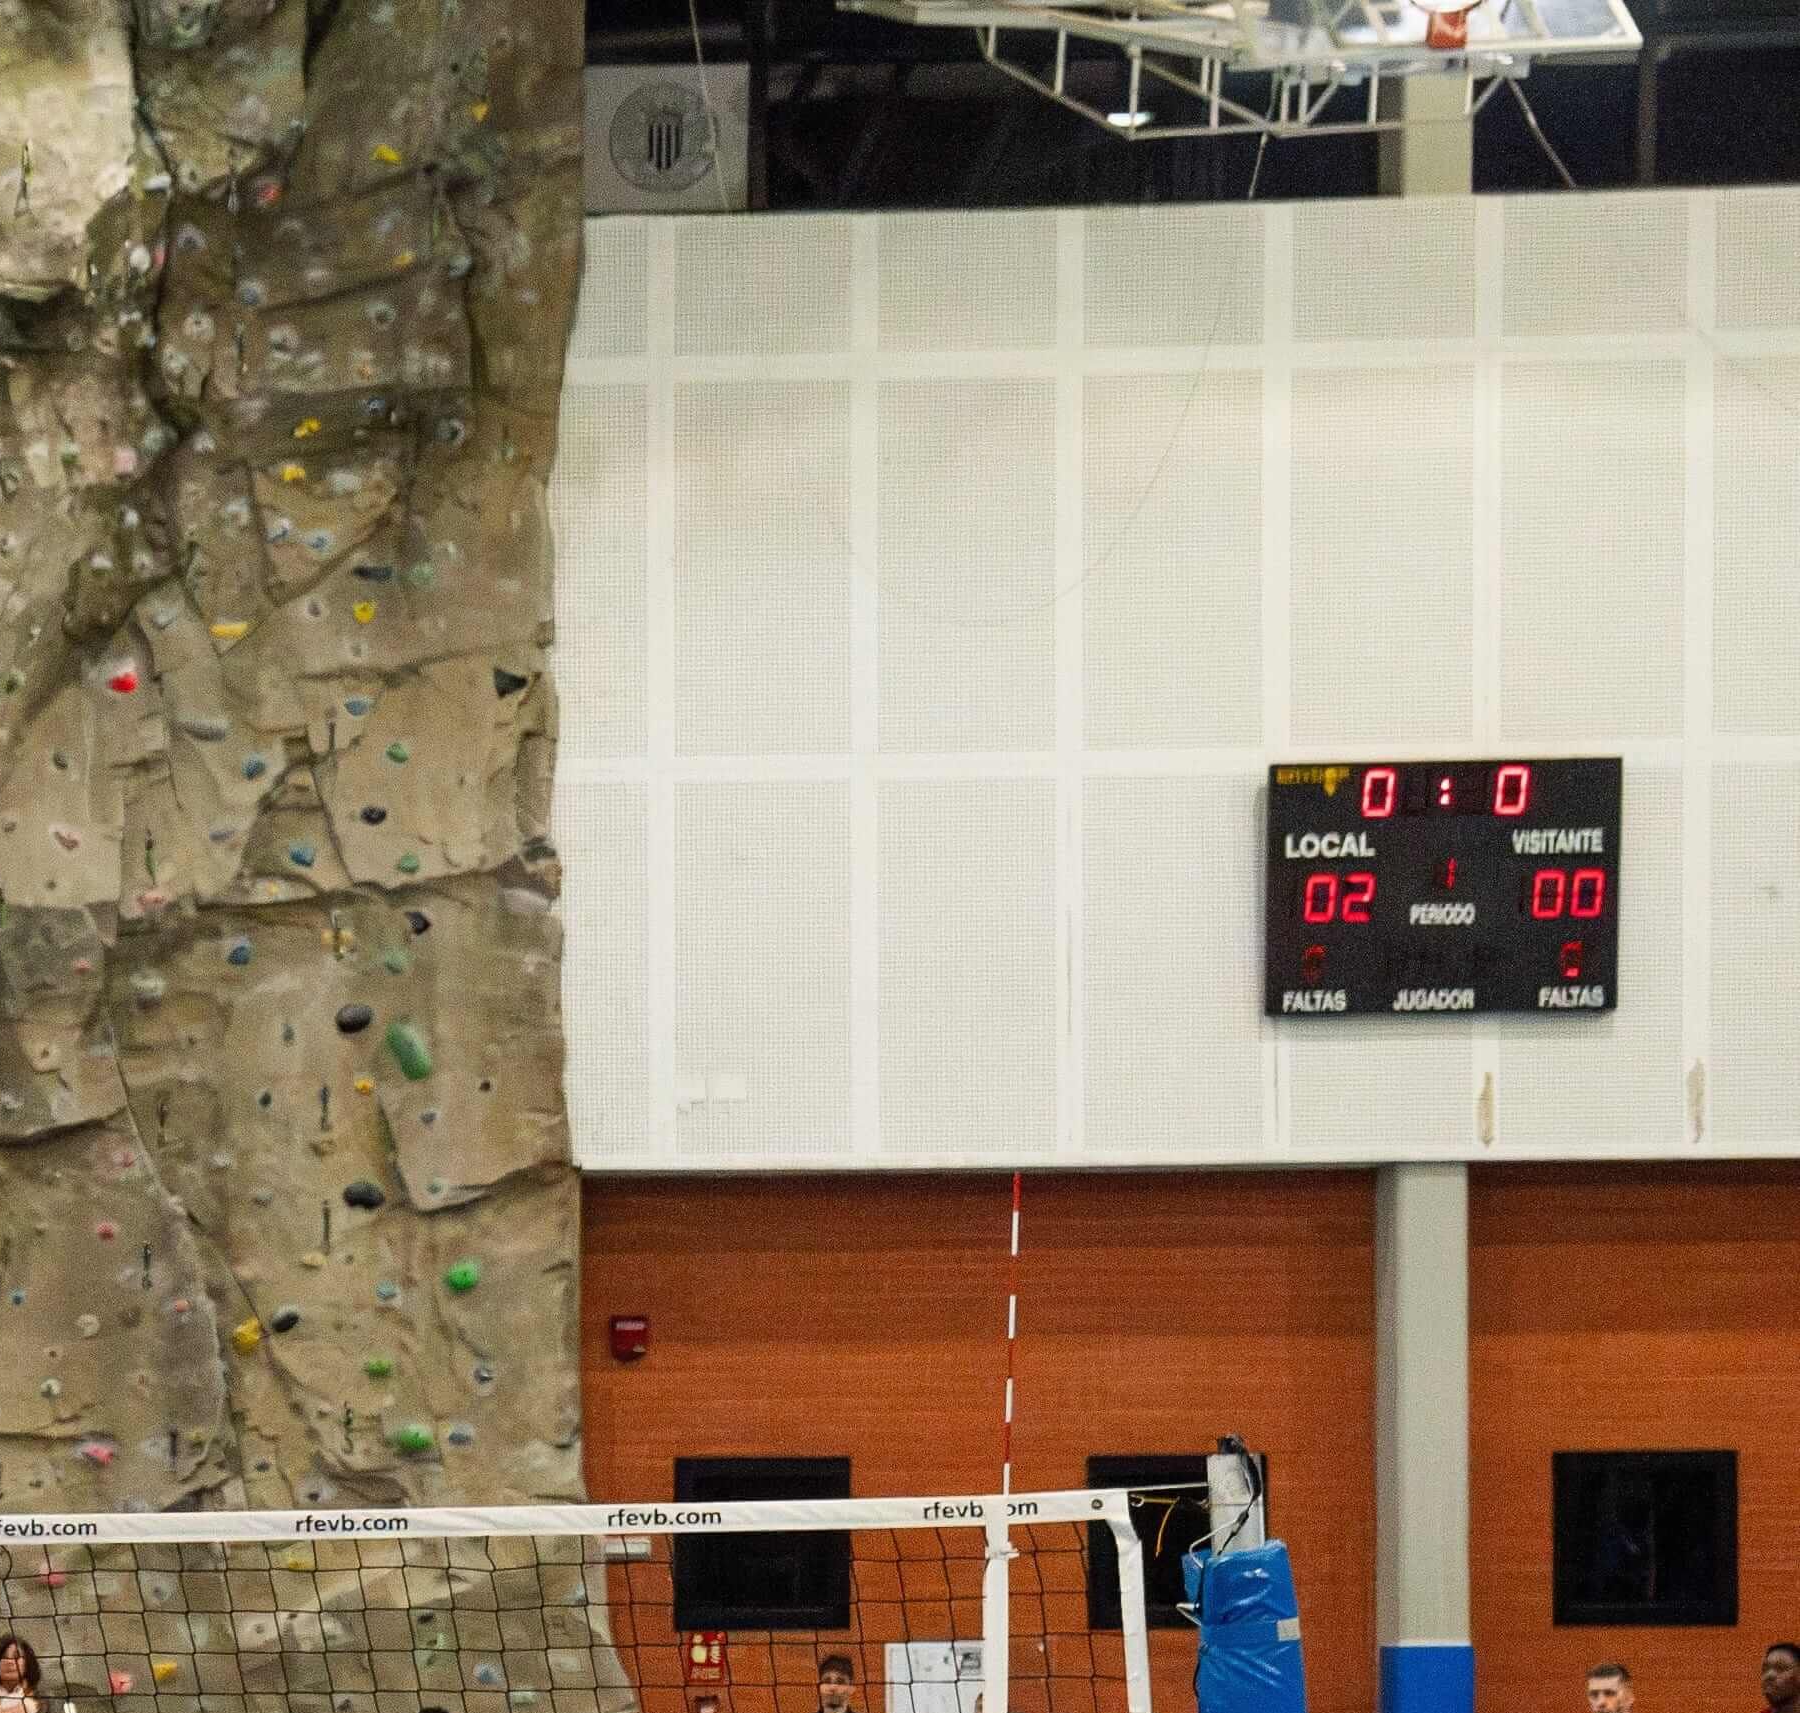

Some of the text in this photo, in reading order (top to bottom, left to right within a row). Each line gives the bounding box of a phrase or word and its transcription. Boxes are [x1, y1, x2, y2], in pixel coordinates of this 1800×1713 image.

[1285, 832, 1375, 858] LOCAL
[1512, 828, 1604, 855] VISITANTE
[1303, 873, 1376, 924] 02
[1531, 869, 1603, 920] 00
[1409, 902, 1476, 926] PERIODO
[1282, 989, 1347, 1013] FALTAS
[1392, 987, 1475, 1012] JUGADOR
[1538, 985, 1604, 1009] FALTAS
[607, 1507, 722, 1526] rfevb.com
[923, 1498, 1039, 1520] rfevbom
[295, 1513, 409, 1533] rfevb.com
